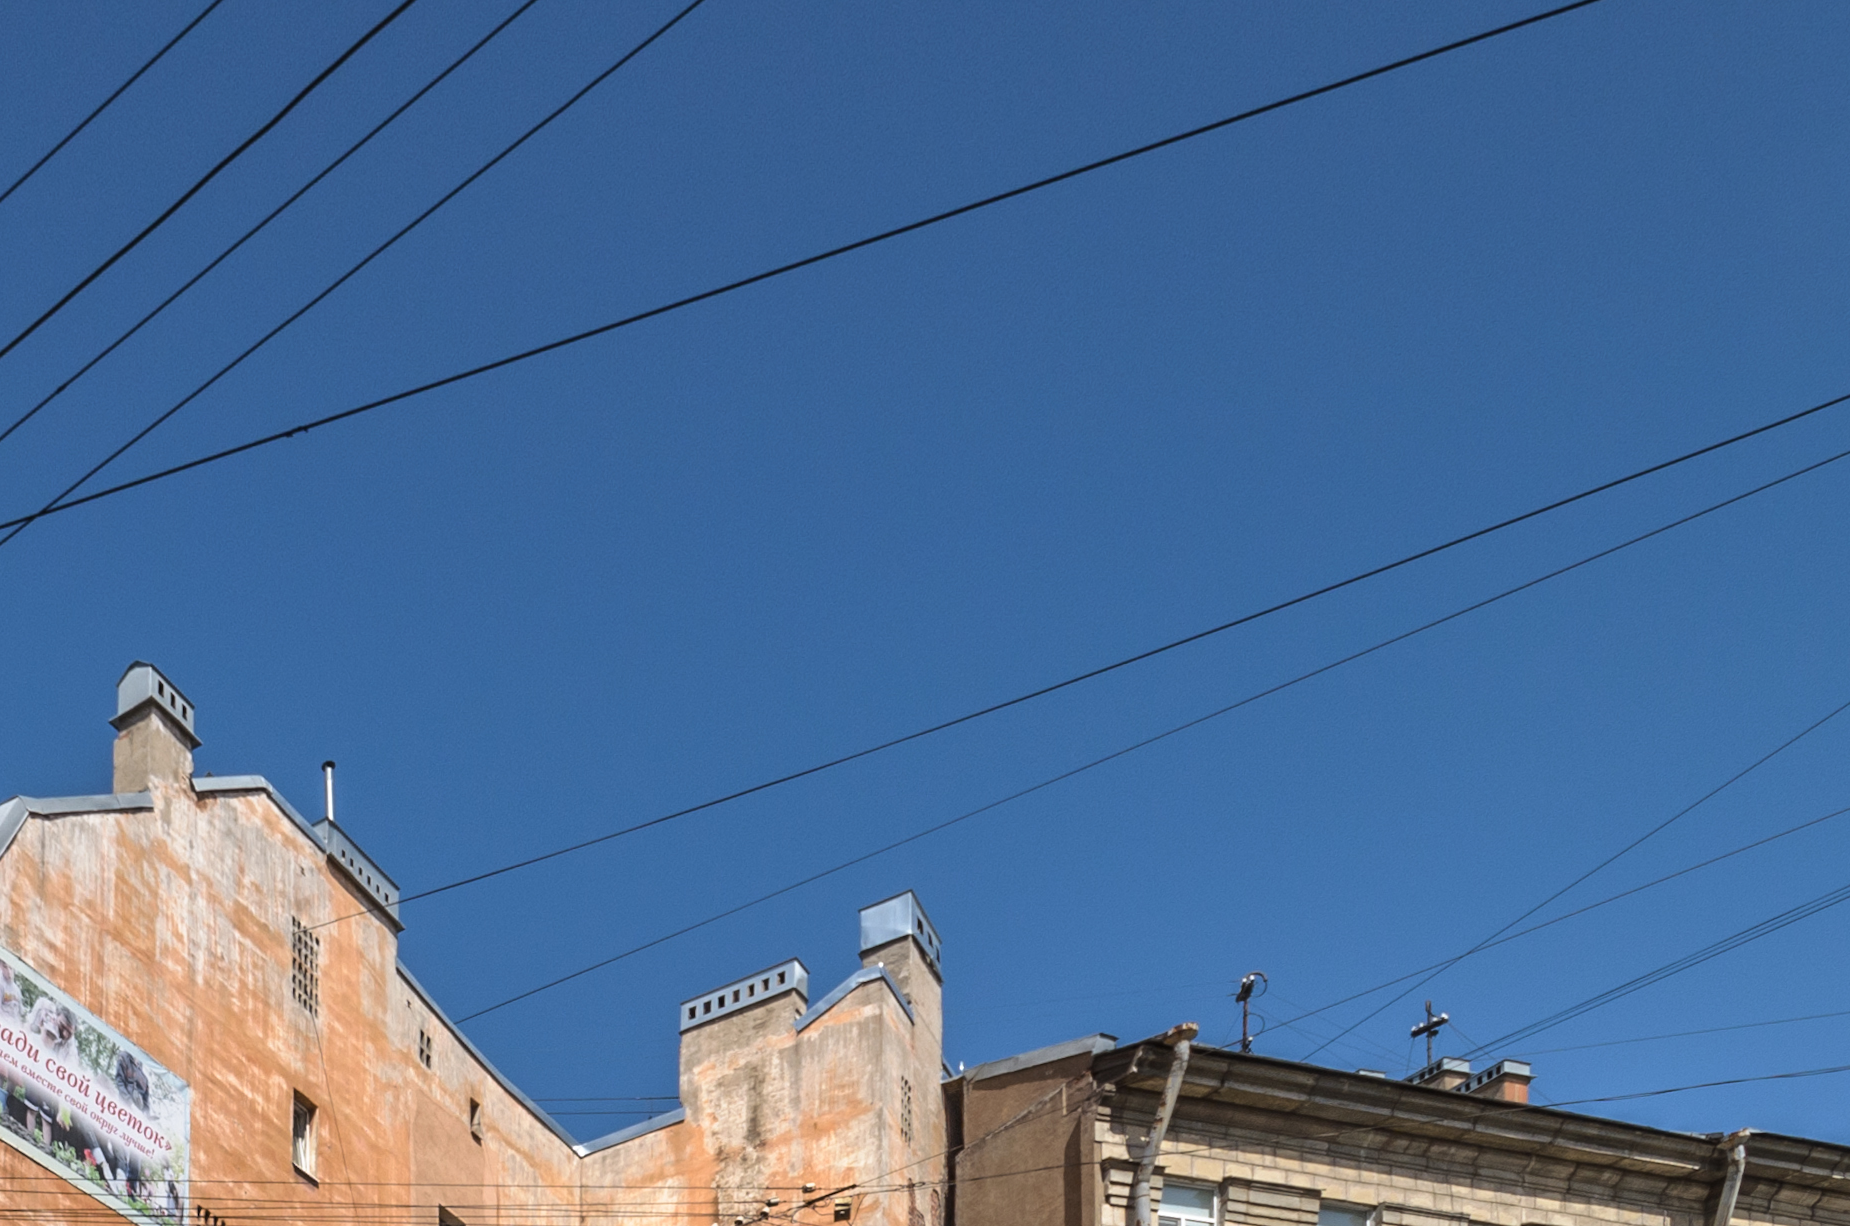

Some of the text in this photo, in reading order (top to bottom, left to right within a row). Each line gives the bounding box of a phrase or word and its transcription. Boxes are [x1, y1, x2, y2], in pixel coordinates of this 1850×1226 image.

[21, 1064, 63, 1097] вместе
[64, 1093, 88, 1115] свой
[89, 1111, 119, 1135] округ
[119, 1132, 155, 1159] лучше!
[45, 1058, 91, 1098] свой
[95, 1090, 172, 1151] цветок»
